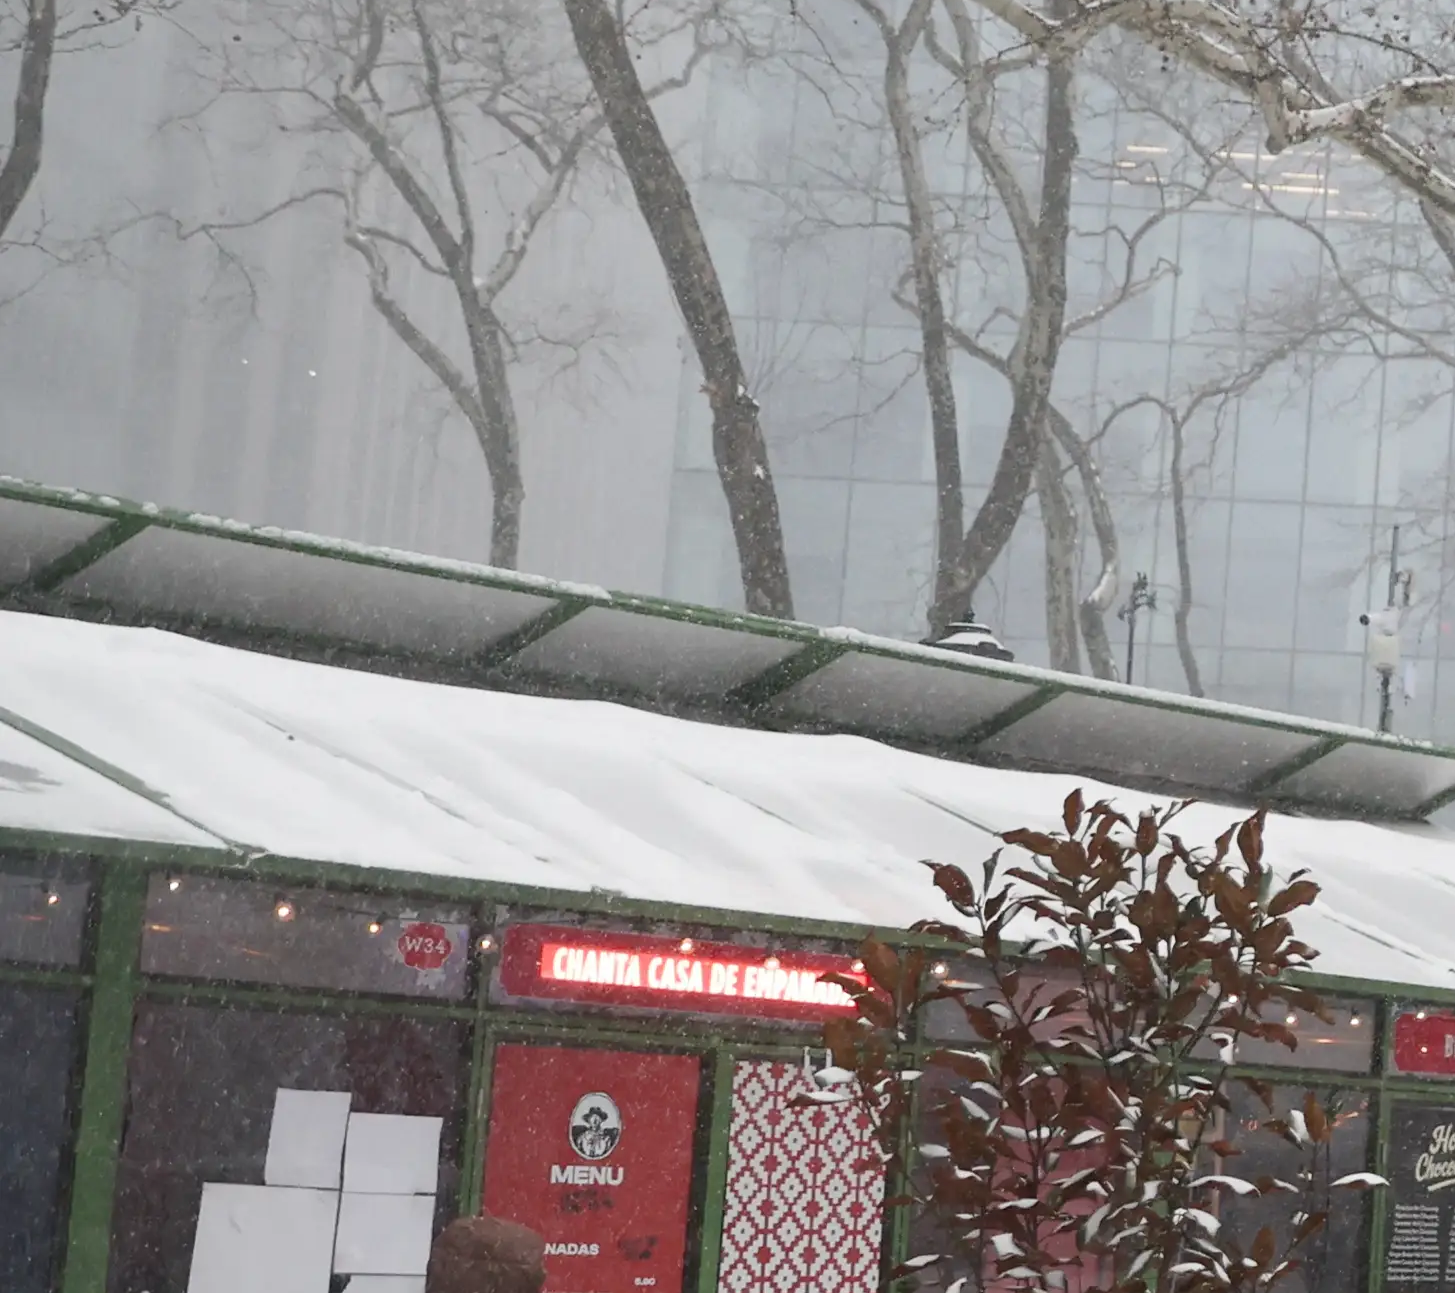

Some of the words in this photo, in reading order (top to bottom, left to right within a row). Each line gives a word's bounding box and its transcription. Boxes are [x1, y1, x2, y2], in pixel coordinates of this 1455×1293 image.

[404, 936, 446, 954] W34
[552, 946, 641, 988] CHANTA
[648, 956, 703, 992] CASA
[708, 960, 738, 995] DE
[551, 1165, 625, 1186] MENU
[544, 1243, 600, 1256] NADAS
